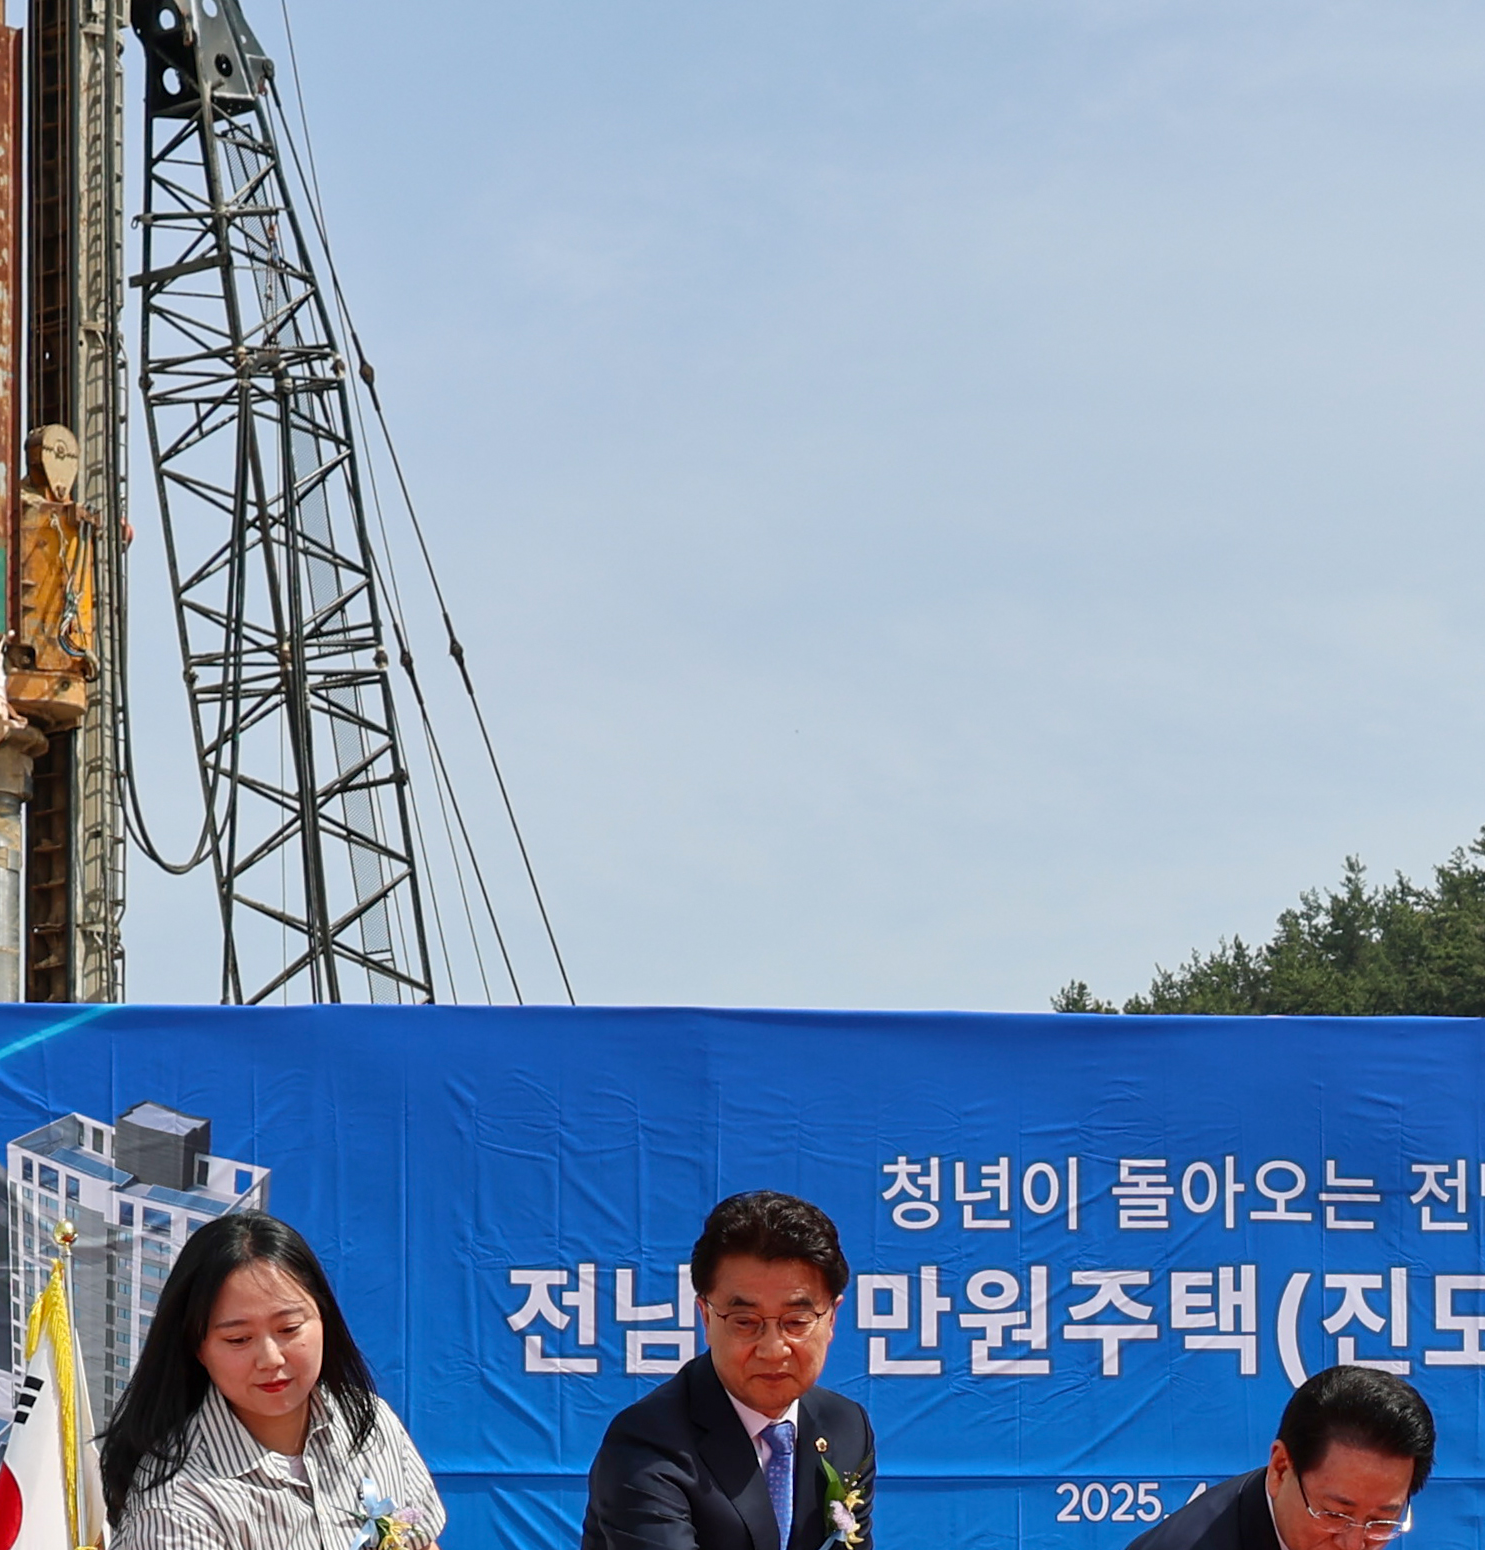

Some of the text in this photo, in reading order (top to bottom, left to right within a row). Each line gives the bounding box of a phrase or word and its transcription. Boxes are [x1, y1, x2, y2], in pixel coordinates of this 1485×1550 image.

[882, 1156, 1079, 1231] 청년이
[1111, 1156, 1381, 1230] 돌아오는
[507, 1263, 697, 1374] 전남
[1055, 1482, 1171, 1523] 2025.
